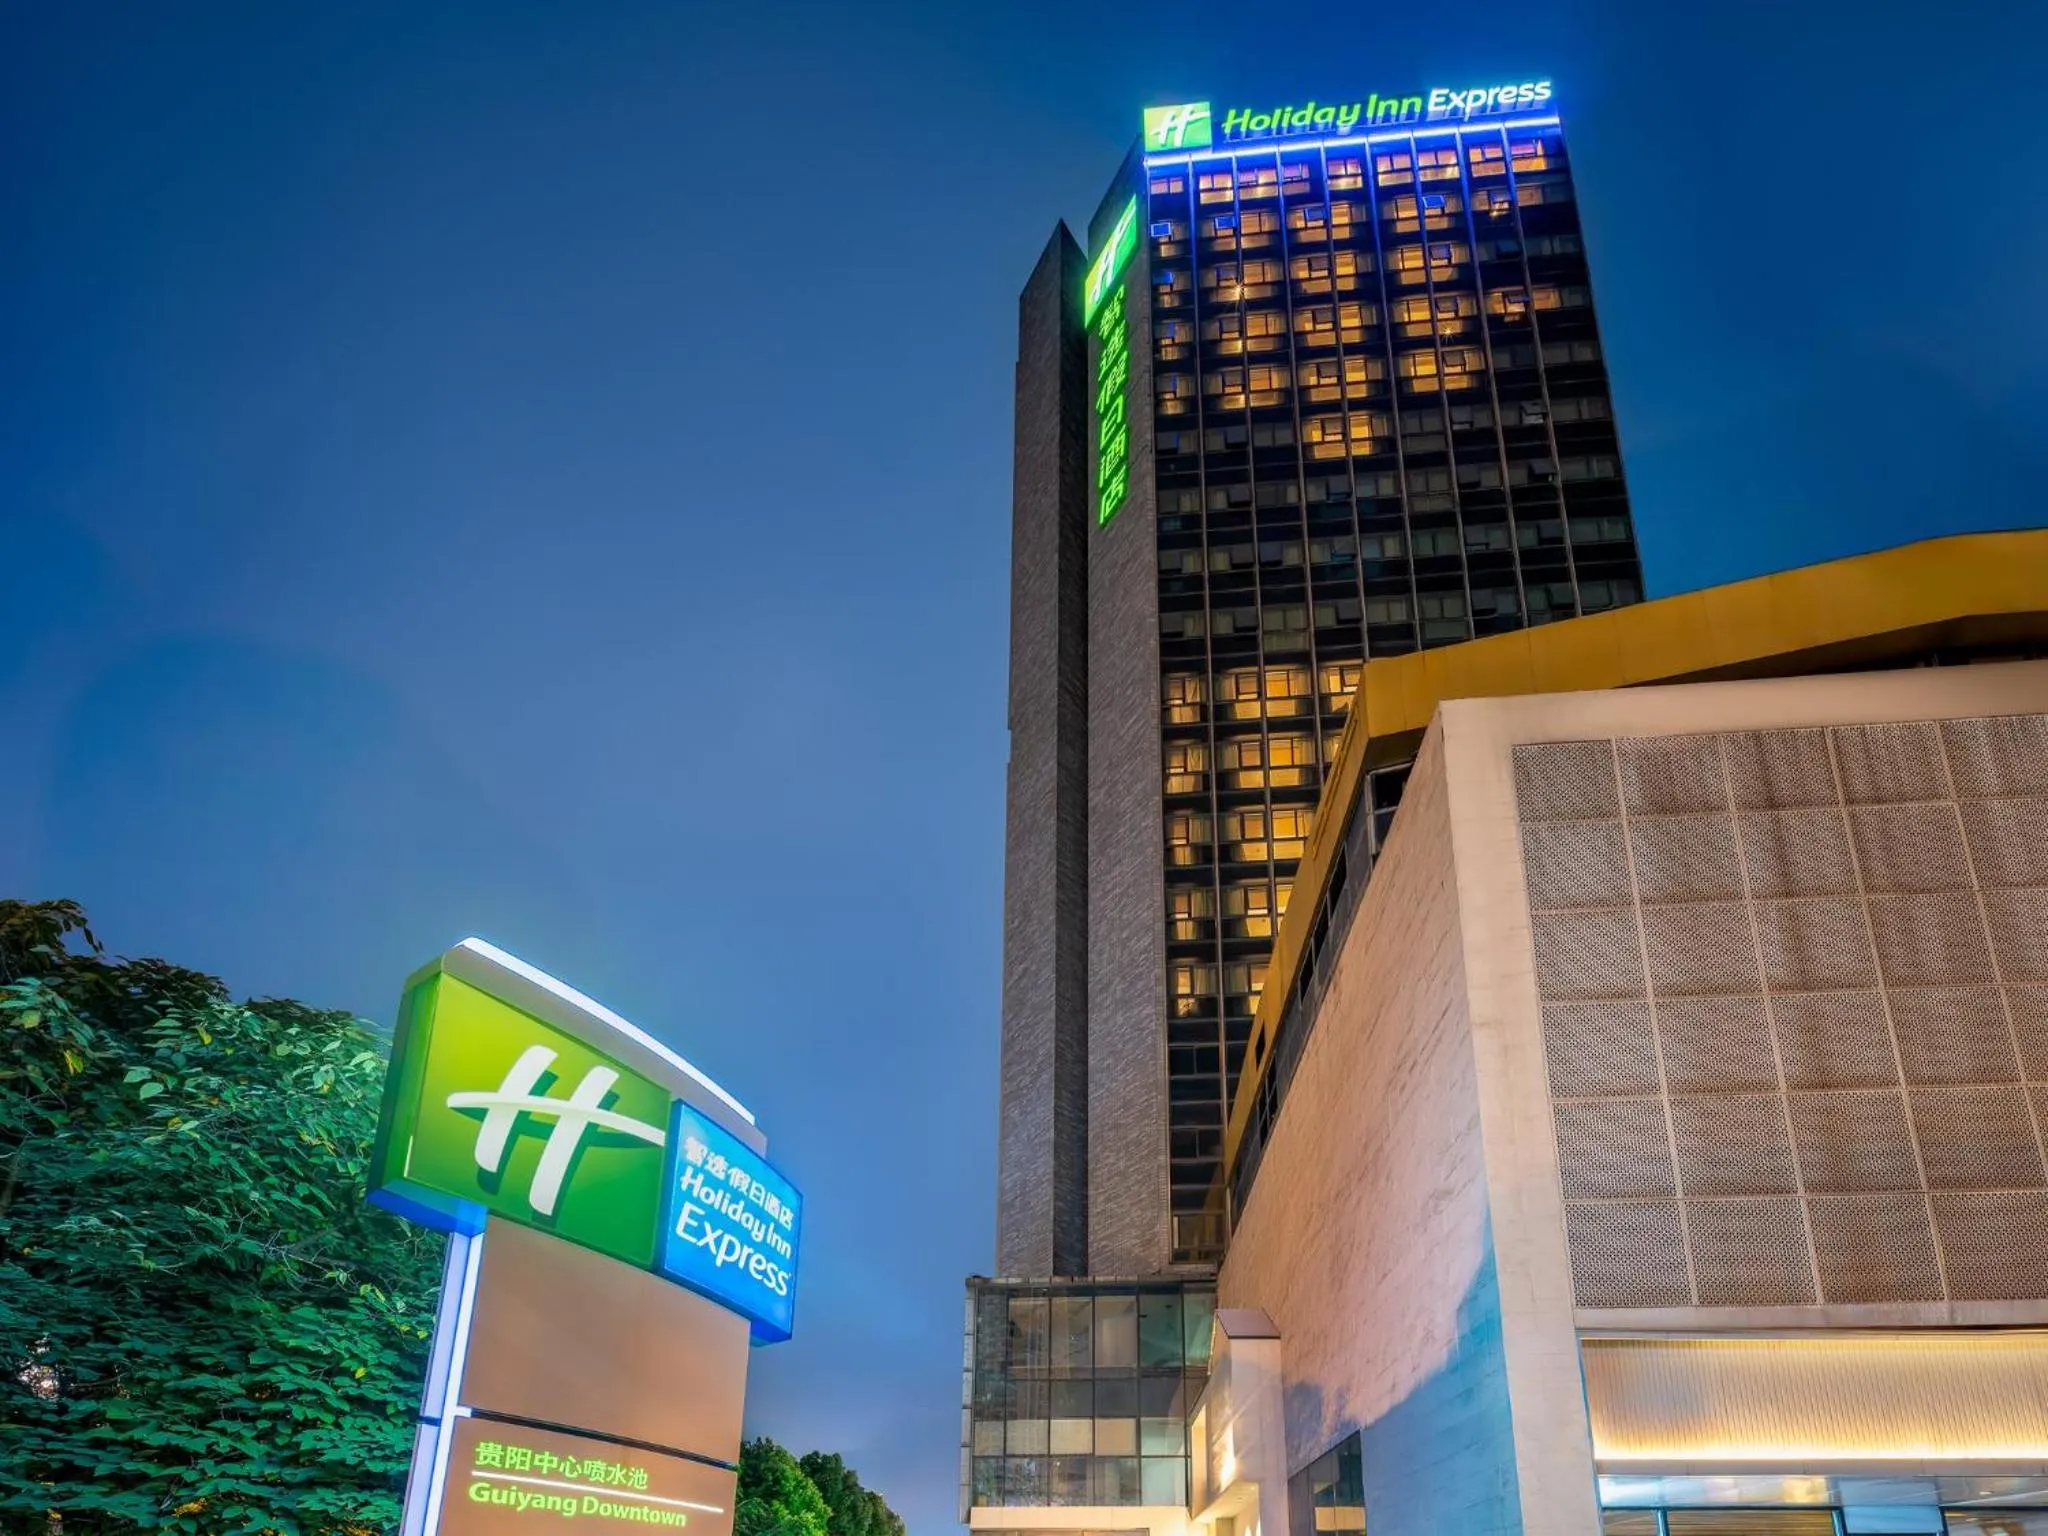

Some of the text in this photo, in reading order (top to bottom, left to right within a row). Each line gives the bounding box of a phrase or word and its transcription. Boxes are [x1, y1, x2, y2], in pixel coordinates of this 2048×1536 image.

[1223, 81, 1552, 135] Holiday Inn Express
[681, 1166, 792, 1260] Holiday Inn
[676, 1201, 790, 1296] Express
[475, 1441, 649, 1490] 贵阳中心喷水池
[469, 1482, 688, 1528] Guiyang Downtown
